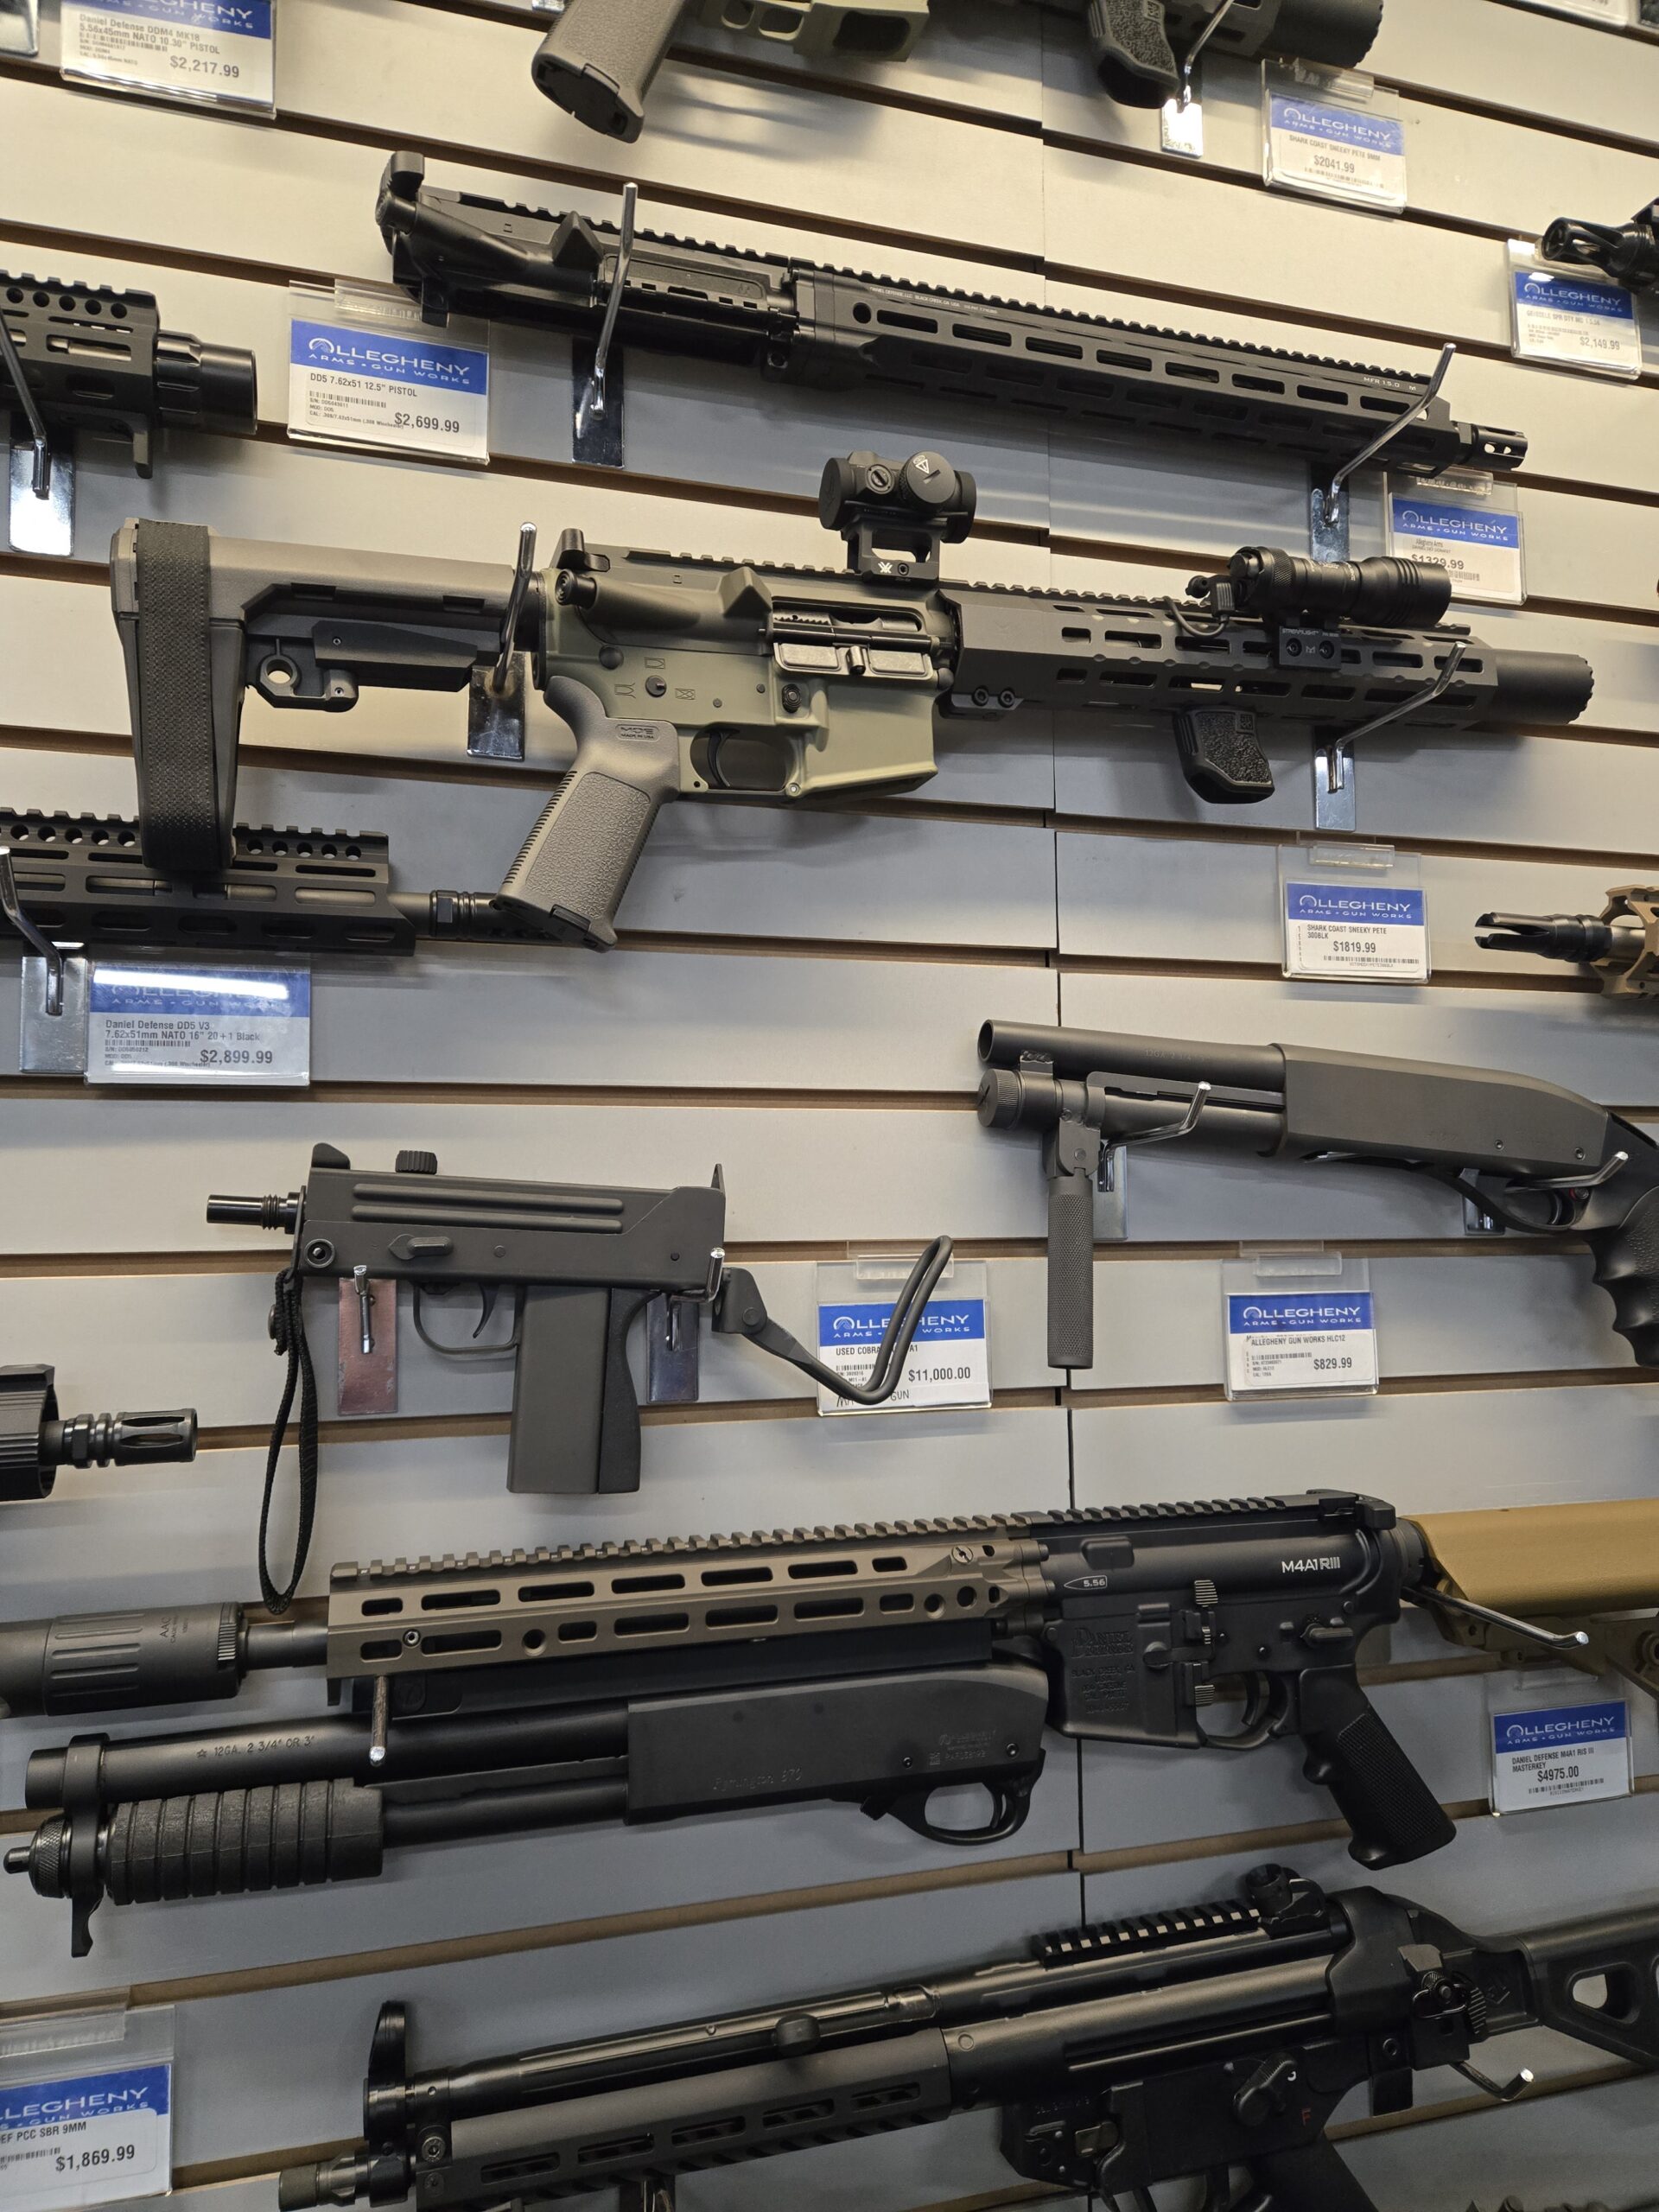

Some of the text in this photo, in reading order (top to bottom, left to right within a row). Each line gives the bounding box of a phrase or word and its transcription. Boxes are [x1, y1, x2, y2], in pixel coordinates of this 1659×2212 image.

[79, 14, 201, 42] Daniel Defense DDM4 MK18
[133, 32, 157, 44] NATO
[190, 42, 221, 55] PISTOL
[169, 55, 241, 79] $2,217.99
[1284, 107, 1392, 142] ALLEGHENY
[1314, 155, 1356, 174] $2041.99
[1524, 283, 1622, 307] ALLEGHENY
[1580, 336, 1621, 352] $2,149.99
[308, 338, 471, 377] ALLEGHENY
[308, 353, 471, 385] ARMS GUN WORKS
[310, 372, 418, 397] DD5 7.62x51 12.5" PISTOL
[394, 412, 461, 434] $2,699.99
[1402, 511, 1508, 535] ALLEGHENY
[1402, 523, 1510, 542] ARMS GUN WORKS
[1300, 894, 1412, 912] ALLEGHENY
[1333, 941, 1377, 954] $1819.99
[105, 1020, 211, 1031] Daniel Defense DD5 V3
[105, 1030, 159, 1040] 7.62x51mm
[162, 1031, 187, 1040] NATO
[237, 1032, 261, 1041] Black
[200, 1050, 274, 1066] $2,899.99
[1243, 1306, 1362, 1319] ALLEGHENY
[834, 1315, 970, 1331] ALLEHENY
[1251, 1337, 1287, 1347] ALLEGHENY
[1303, 1336, 1325, 1344] WORKS
[836, 1347, 856, 1357] USED
[858, 1346, 880, 1355] COBRA
[1313, 1357, 1353, 1371] $829.99
[908, 1367, 971, 1383] $11,000.00
[890, 1389, 911, 1402] GUN
[1084, 1579, 1106, 1588] 5.56
[1507, 1717, 1616, 1738] ALLEGHENY
[247, 1743, 254, 1753] 2
[286, 1738, 301, 1749] OR
[1507, 1737, 1539, 1745] ARMS
[1512, 1756, 1533, 1765] DANIEL
[1534, 1752, 1560, 1763] DEFENSE
[1512, 1762, 1547, 1773] MASTERKEY
[1537, 1766, 1580, 1783] $4975.00
[29, 2102, 149, 2126] GUN WORKS
[17, 2128, 37, 2142] PCC
[40, 2125, 60, 2139] SBR
[63, 2121, 87, 2135] 9MM
[55, 2145, 136, 2172] $1,869.99
